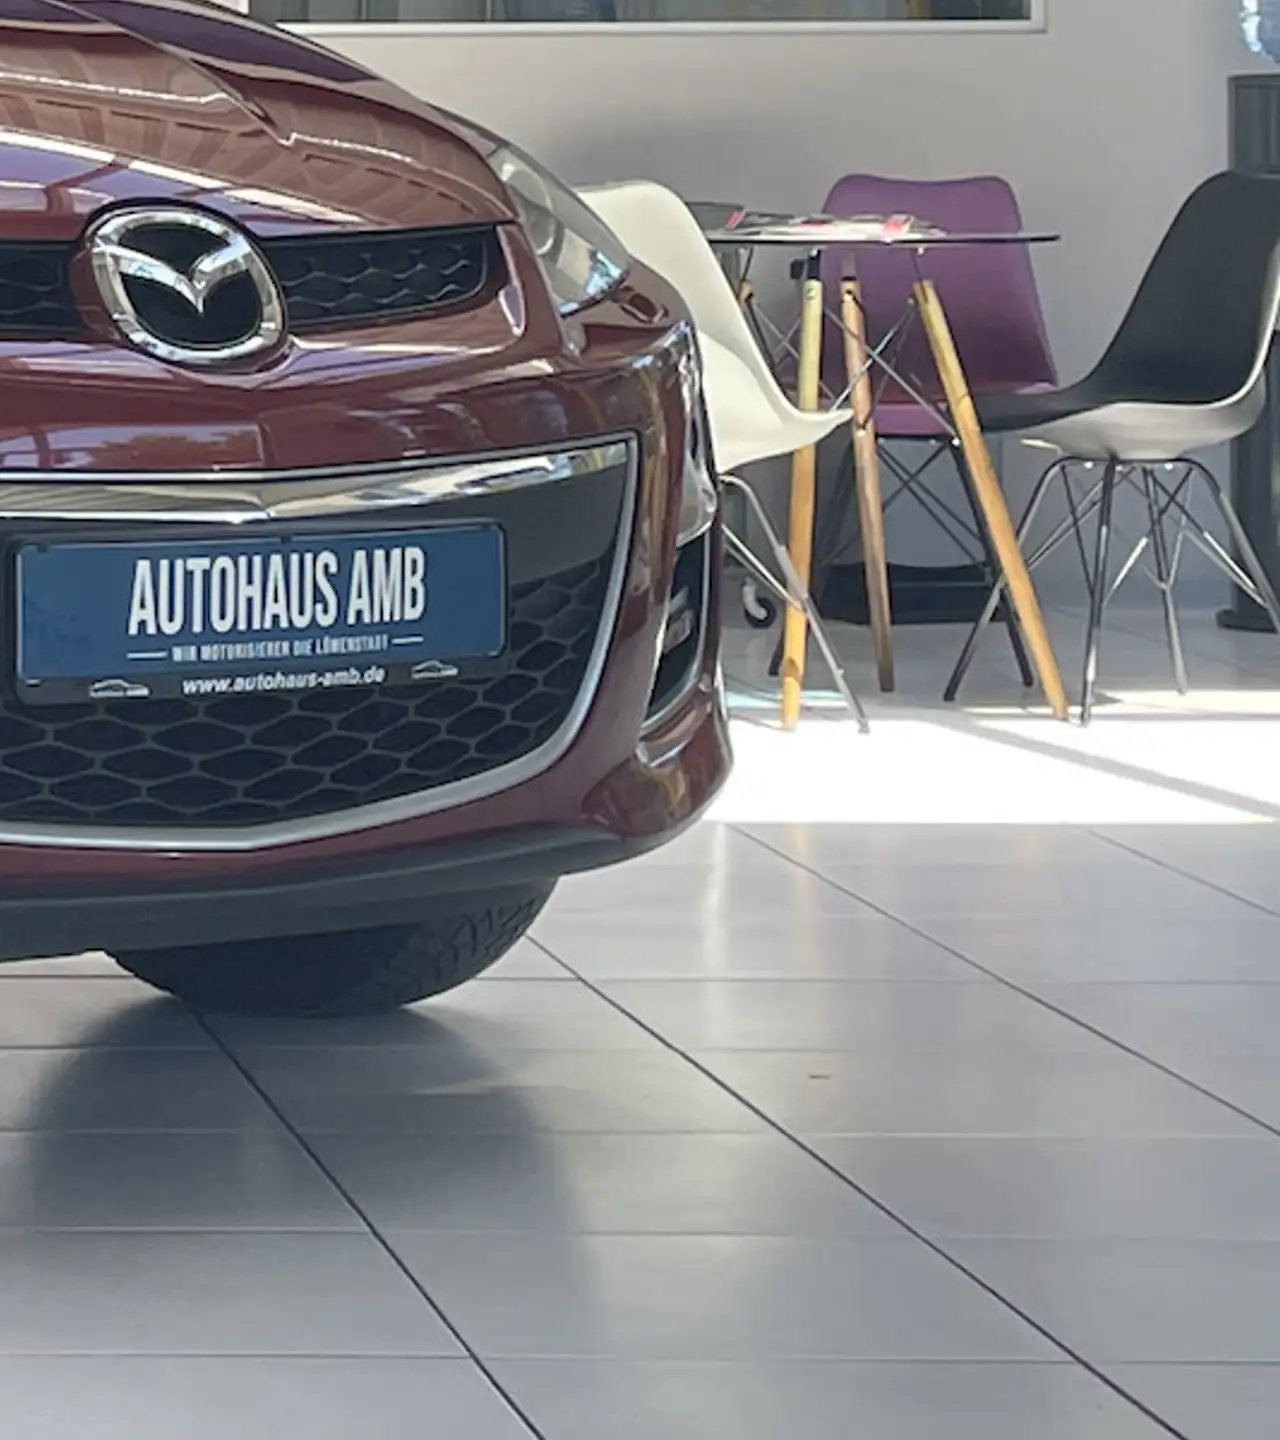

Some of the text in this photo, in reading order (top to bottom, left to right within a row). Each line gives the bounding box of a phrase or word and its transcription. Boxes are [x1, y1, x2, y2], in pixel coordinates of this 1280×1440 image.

[127, 546, 425, 636] AUTOHAUS AMB
[172, 645, 197, 662] WIR
[293, 638, 313, 656] DIE
[182, 665, 386, 695] www.autohaus-amb.de
